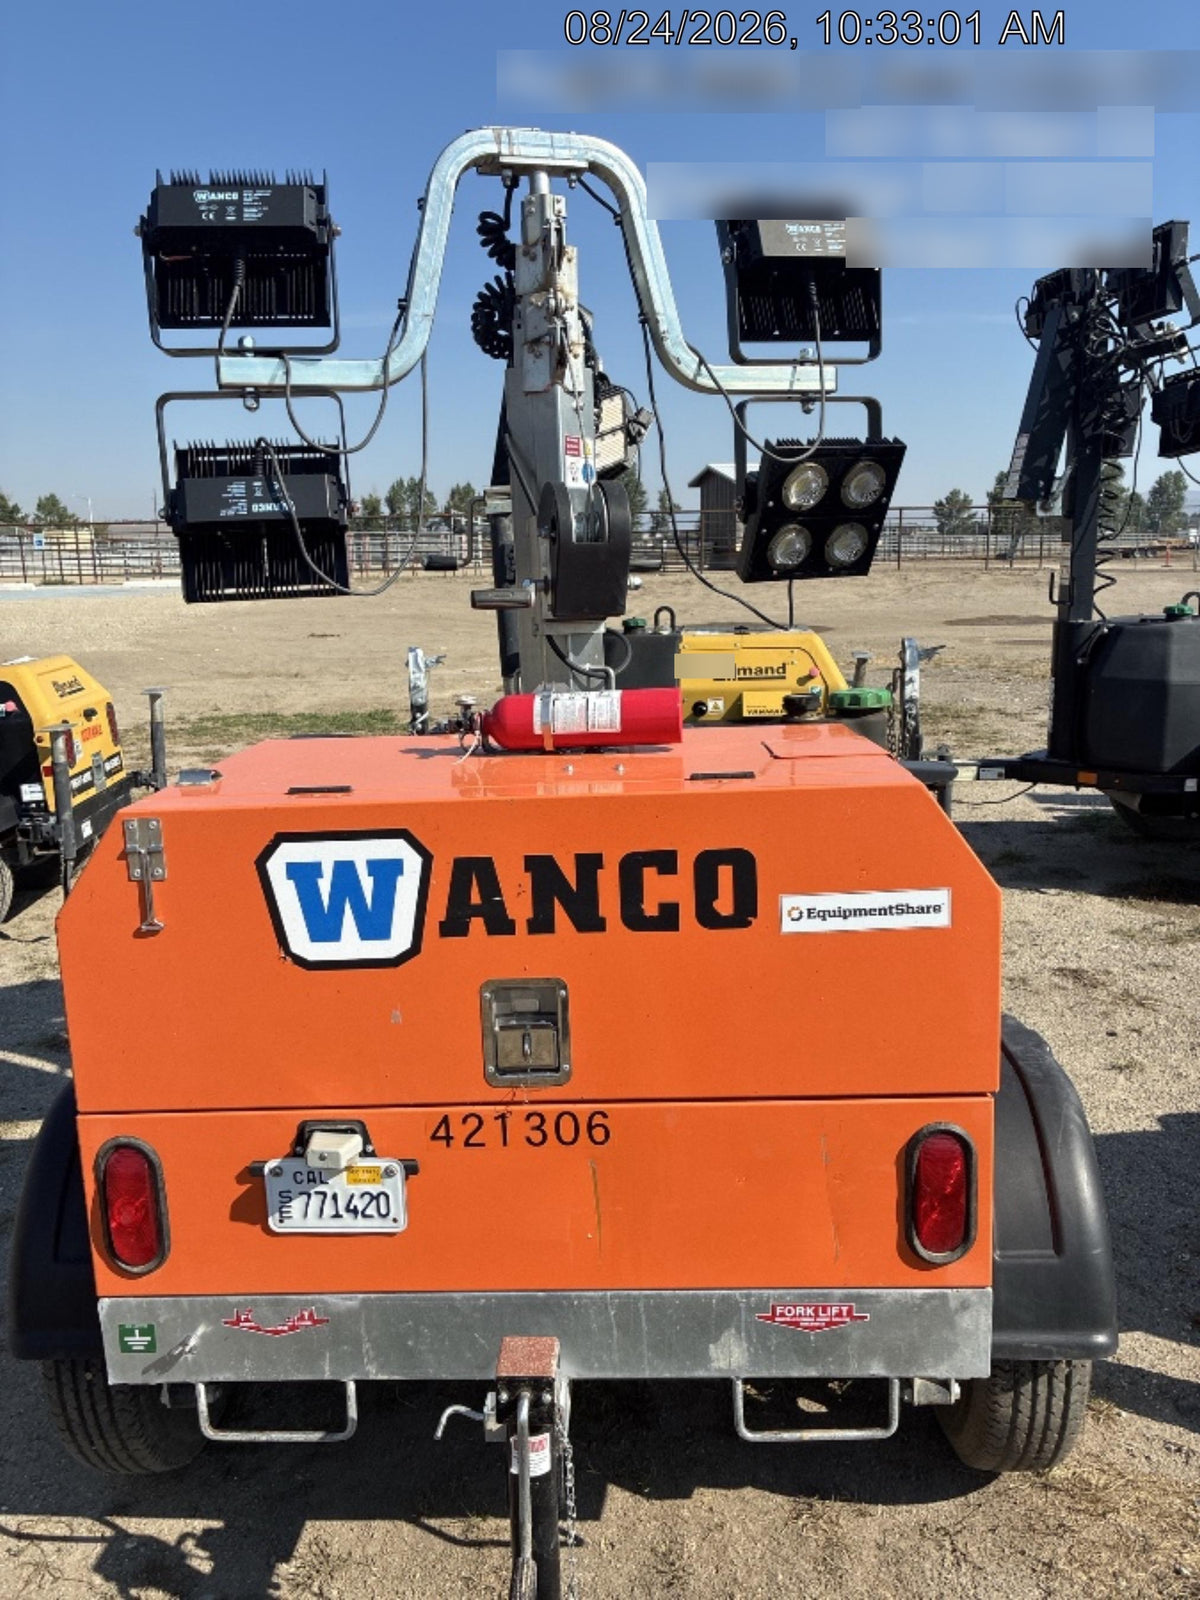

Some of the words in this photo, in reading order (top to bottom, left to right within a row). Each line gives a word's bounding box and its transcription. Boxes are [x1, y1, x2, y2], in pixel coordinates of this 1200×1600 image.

[286, 848, 758, 942] WANCO
[806, 903, 943, 921] EquipmentShare
[429, 1110, 611, 1148] 421306
[293, 1170, 329, 1185] CAL
[298, 1190, 391, 1219] 771420
[776, 1306, 815, 1317] FORK
[819, 1306, 849, 1317] LIFT
